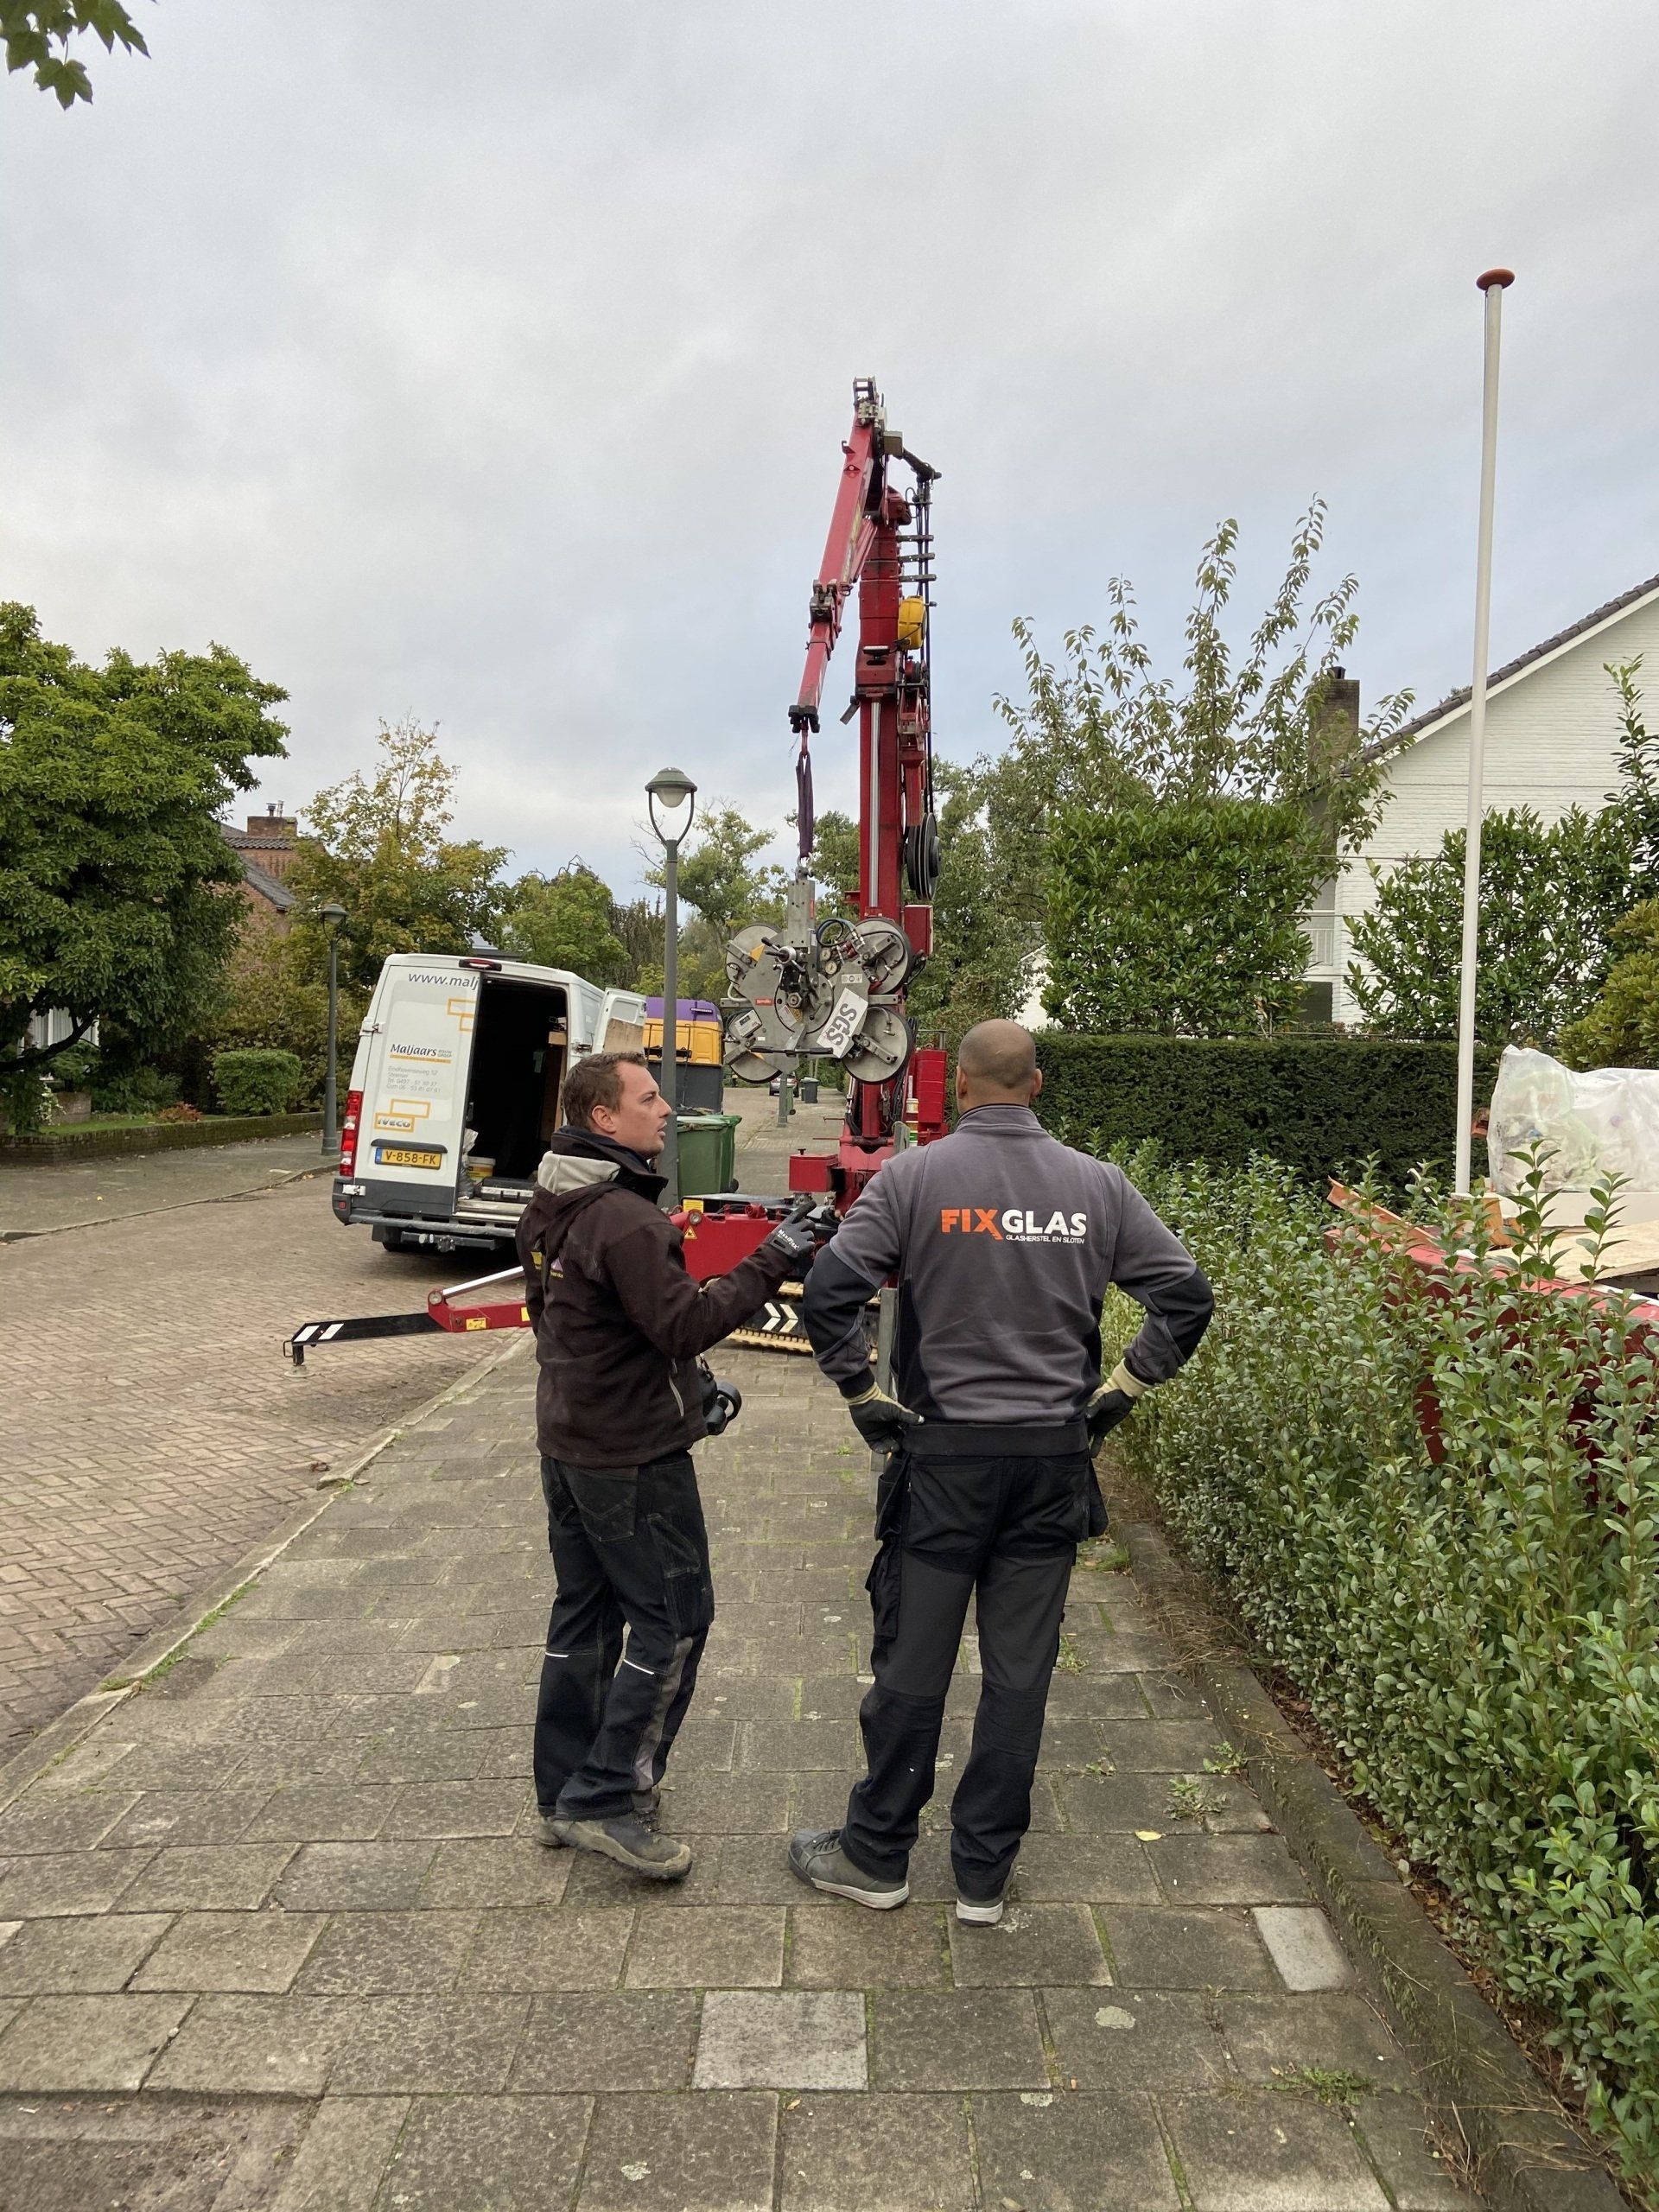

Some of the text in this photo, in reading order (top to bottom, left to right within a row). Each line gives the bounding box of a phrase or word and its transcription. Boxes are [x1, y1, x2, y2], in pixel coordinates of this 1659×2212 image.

[826, 1002, 857, 1046] SGS
[391, 1044, 437, 1057] Maljaars
[377, 1118, 411, 1128] IVECO
[385, 1151, 435, 1165] V-858-FK
[941, 1208, 1087, 1240] FIXGLAS
